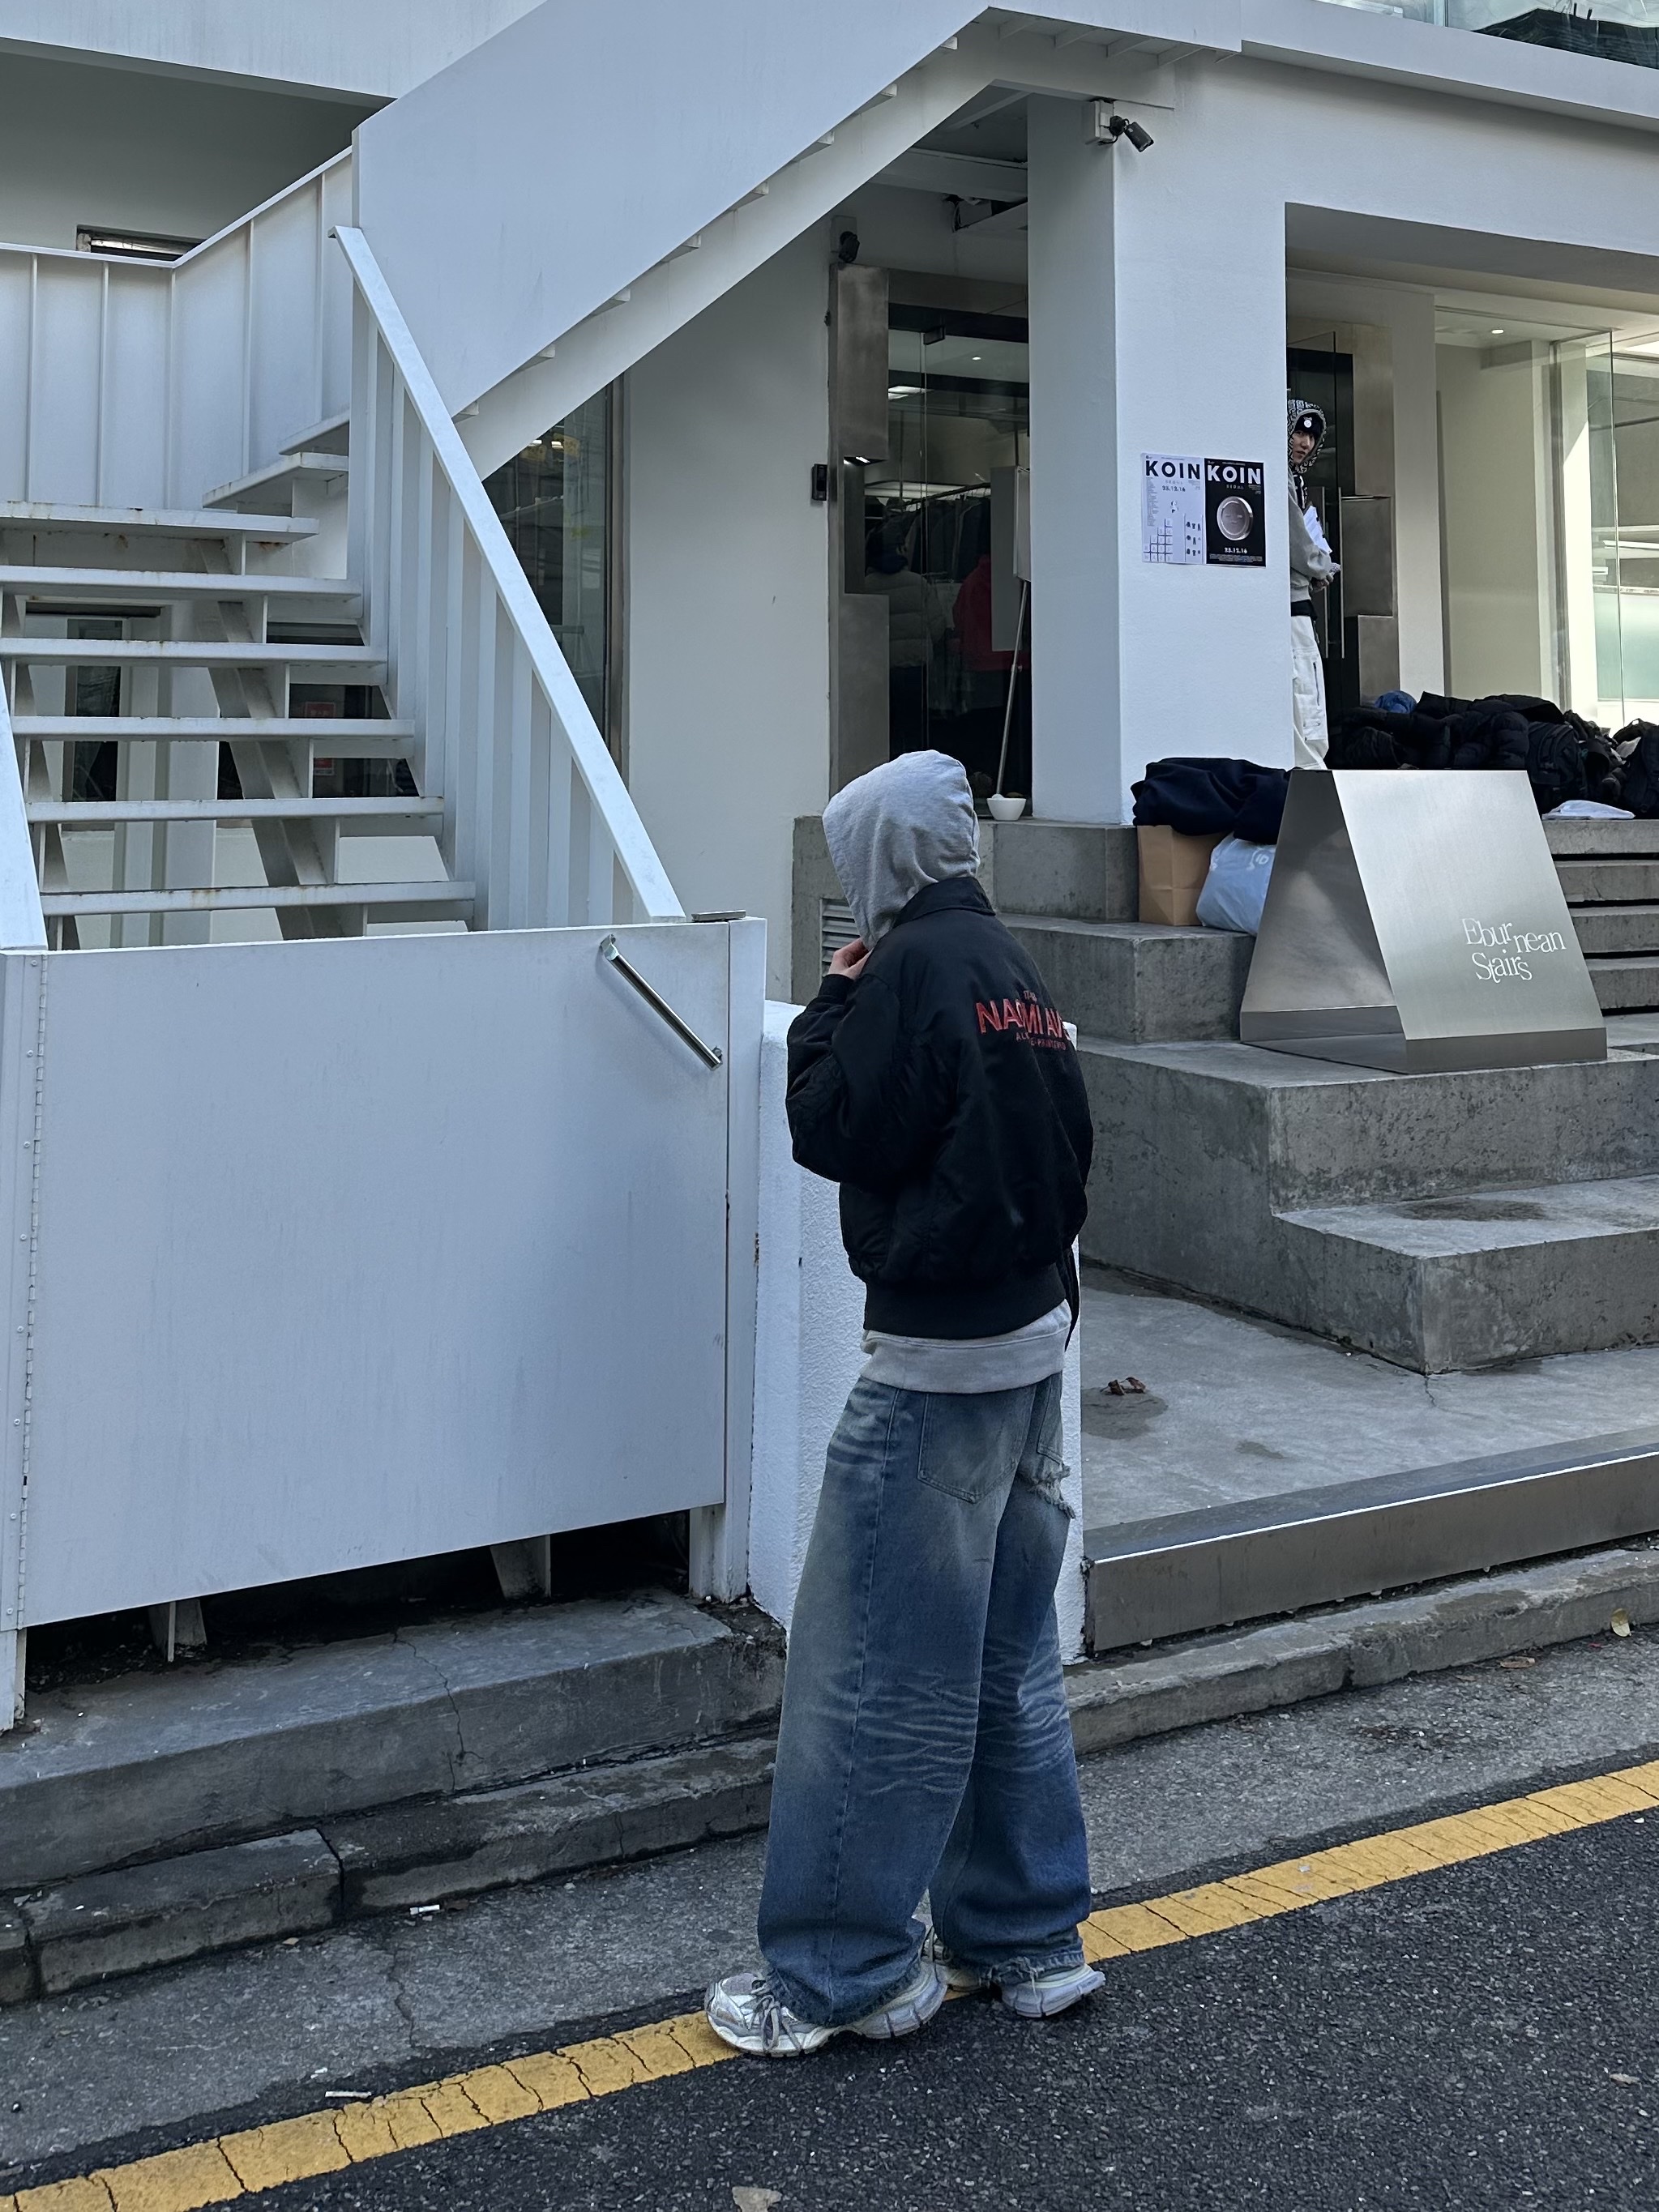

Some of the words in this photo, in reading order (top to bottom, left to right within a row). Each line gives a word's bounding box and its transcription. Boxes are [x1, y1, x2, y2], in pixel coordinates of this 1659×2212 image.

[1146, 460, 1200, 480] KOIN
[1208, 465, 1261, 485] KOIN
[1472, 949, 1533, 984] Stairs
